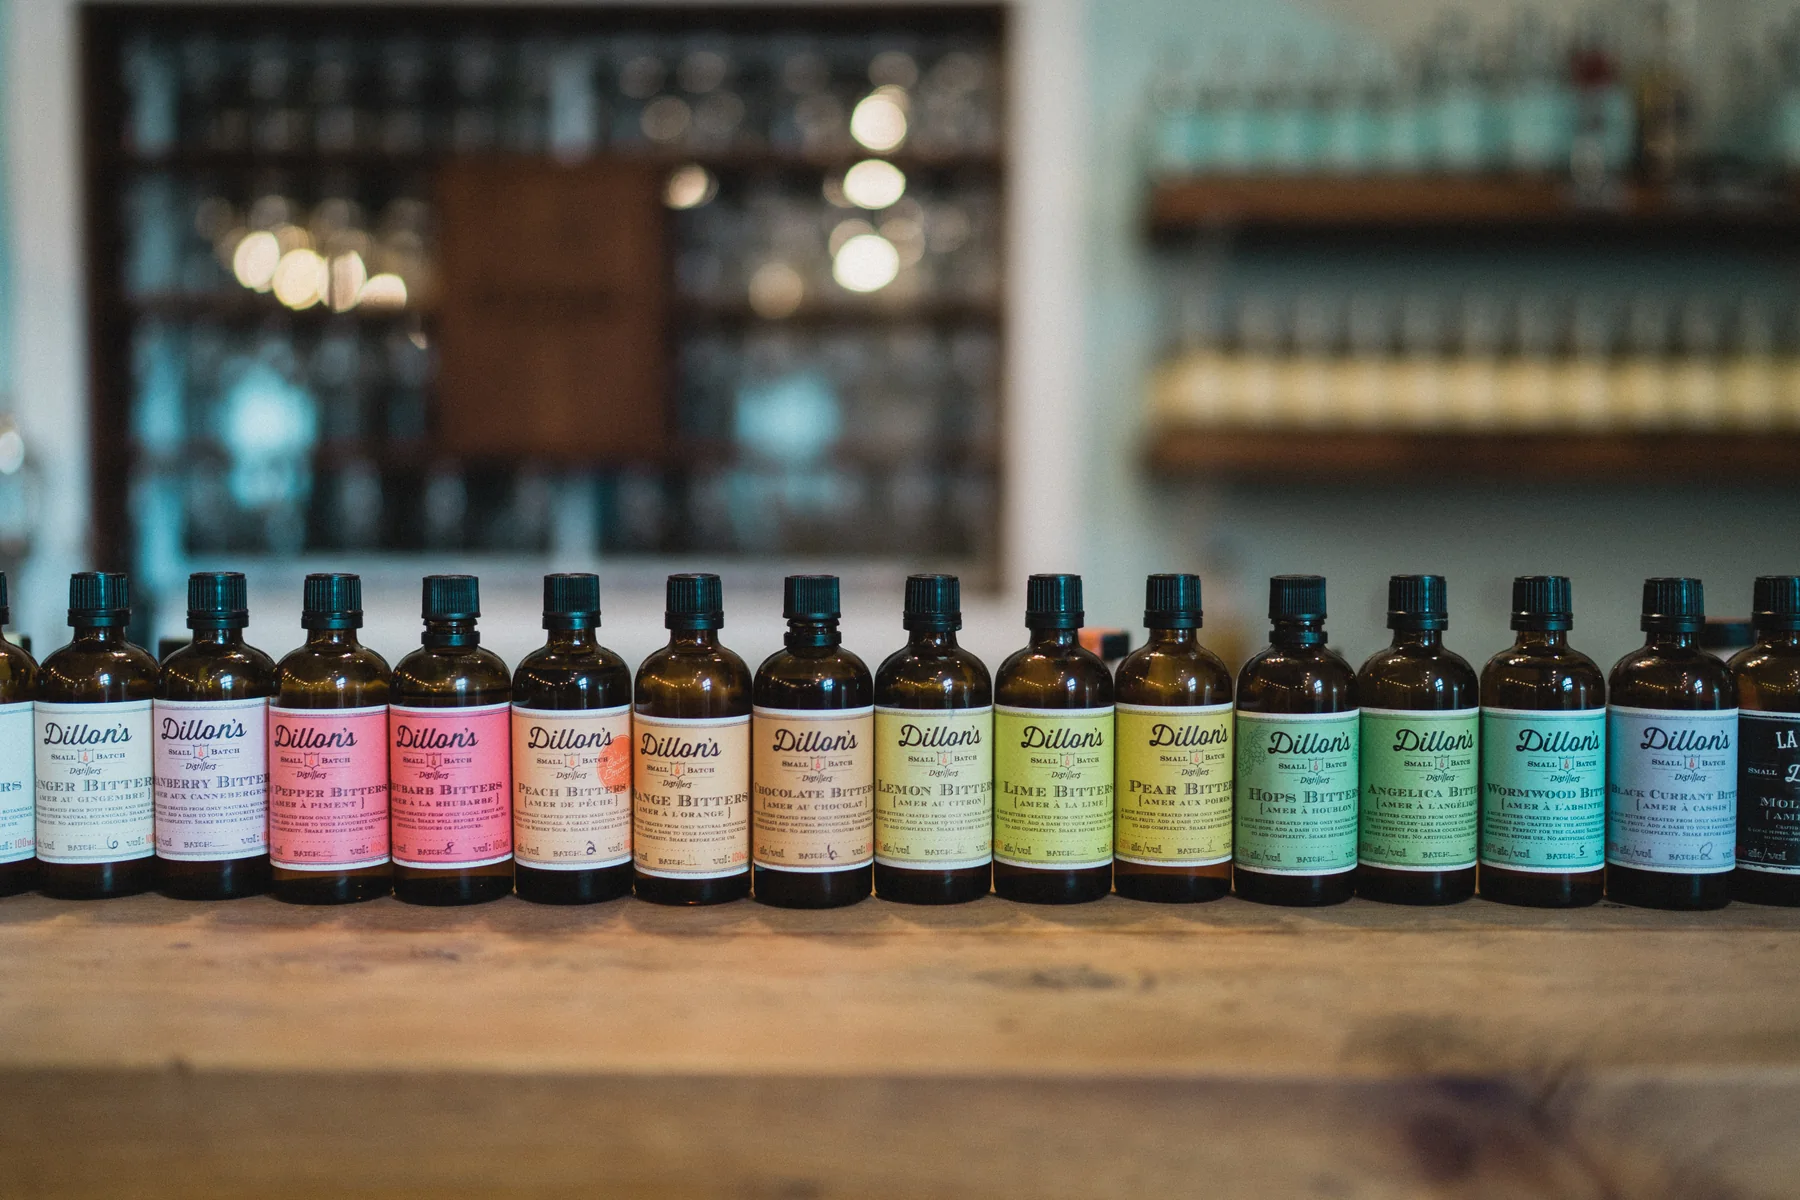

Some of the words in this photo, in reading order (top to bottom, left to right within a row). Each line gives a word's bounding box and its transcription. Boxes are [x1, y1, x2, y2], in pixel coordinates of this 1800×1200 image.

[44, 722, 132, 745] Dillon's
[162, 717, 247, 740] Dillon's
[274, 724, 357, 748] Dillon's
[397, 725, 479, 748] Dillon's
[528, 727, 612, 749] Dillon's
[773, 728, 858, 752] Dillon's
[898, 724, 982, 747] Dillon's
[1021, 725, 1104, 749] Dillon's
[1149, 724, 1228, 747] Dillon's
[1393, 729, 1474, 752] Dillon's
[1516, 729, 1600, 752] Dillon's
[1640, 726, 1730, 751] Dillon's
[1776, 730, 1798, 749] LA
[641, 733, 721, 758] Dillon's
[1268, 731, 1351, 754] Dillon's
[322, 756, 350, 764] BATCH
[403, 756, 425, 764] SMALL
[1031, 756, 1058, 764] SMALL
[1651, 758, 1682, 766] SMALL
[297, 771, 327, 779] Distillers
[647, 764, 668, 773] SMALL
[1052, 771, 1081, 779] Distillers
[1181, 768, 1209, 776] Distillers
[1748, 767, 1778, 776] SMALL
[216, 773, 269, 789] BITTER
[419, 772, 449, 780] Distillers
[556, 772, 587, 780] Distillers
[802, 775, 833, 783] Distillers
[1300, 776, 1330, 785] Distillers
[1426, 774, 1455, 782] Distillers
[1550, 775, 1580, 783] Distillers
[1674, 773, 1706, 782] Distillers
[84, 777, 153, 792] BITTER
[274, 784, 324, 797] PEPPER
[331, 784, 388, 797] BITTERS
[440, 781, 503, 795] BITTERS
[518, 782, 559, 797] PEACH
[566, 784, 626, 797] BITTERS
[663, 780, 692, 788] Distillers
[754, 782, 824, 798] CHOCOLATE
[877, 779, 932, 796] LEMON
[940, 780, 992, 796] BITTER
[1003, 781, 1046, 797] LIME
[1129, 779, 1176, 795] PEAR
[1184, 780, 1233, 795] BITTER
[1487, 782, 1576, 799] WORMWOOD
[78, 792, 145, 802] GINGEMBRE
[634, 788, 671, 806] RANGE
[677, 792, 748, 807] BITTERS
[1249, 787, 1297, 803] HOPS
[1303, 788, 1358, 804] BITTER
[1367, 784, 1443, 798] ANGELICA
[1611, 783, 1645, 797] BLACK
[1649, 789, 1714, 800] CURRANT
[436, 797, 493, 807] RHUBARBE
[579, 799, 613, 808] PÊCHE
[767, 802, 793, 810] AMER
[814, 801, 863, 810] CHOCOLAT
[949, 799, 982, 807] CITRON
[1082, 800, 1104, 808] LIME
[1506, 802, 1539, 810] AMER
[1643, 803, 1677, 811] AMER
[1693, 803, 1727, 812] CASSIS
[672, 810, 724, 818] L'ORANGE
[1312, 805, 1352, 814] HOUBLON
